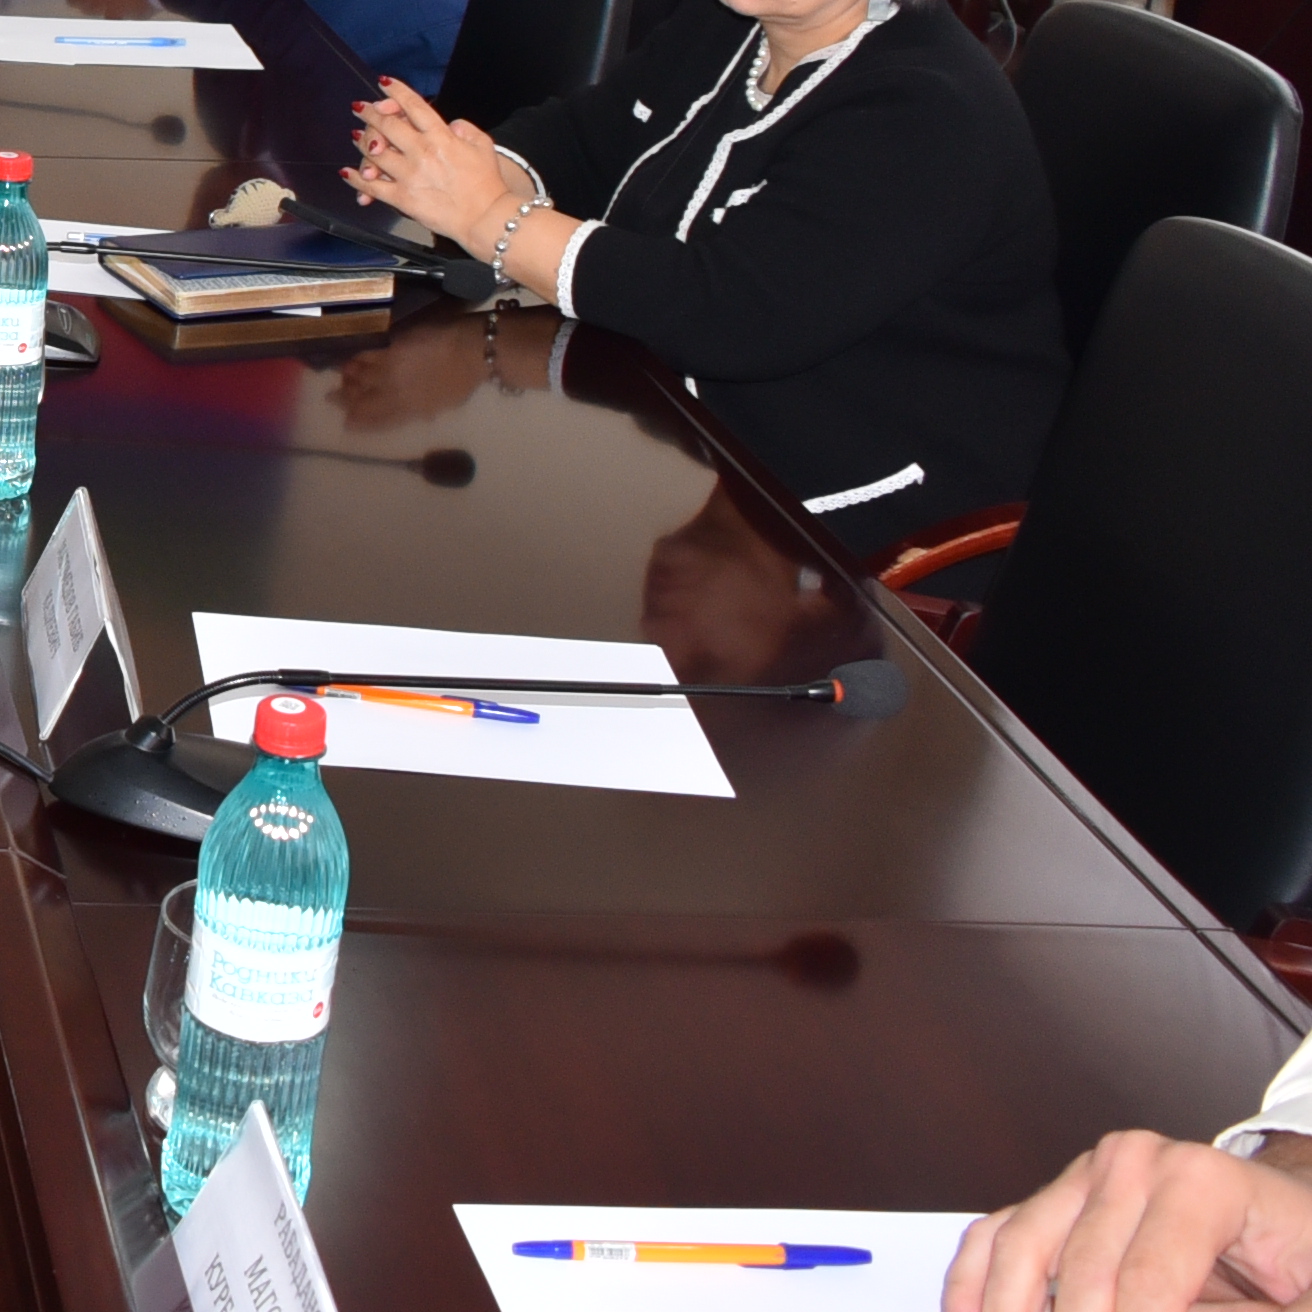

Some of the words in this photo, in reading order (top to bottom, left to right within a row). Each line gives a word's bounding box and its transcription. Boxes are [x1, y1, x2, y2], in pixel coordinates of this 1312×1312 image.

[211, 949, 318, 984] Родники
[209, 970, 314, 1005] Кавказа
[274, 1200, 325, 1312] РАБАДАН
